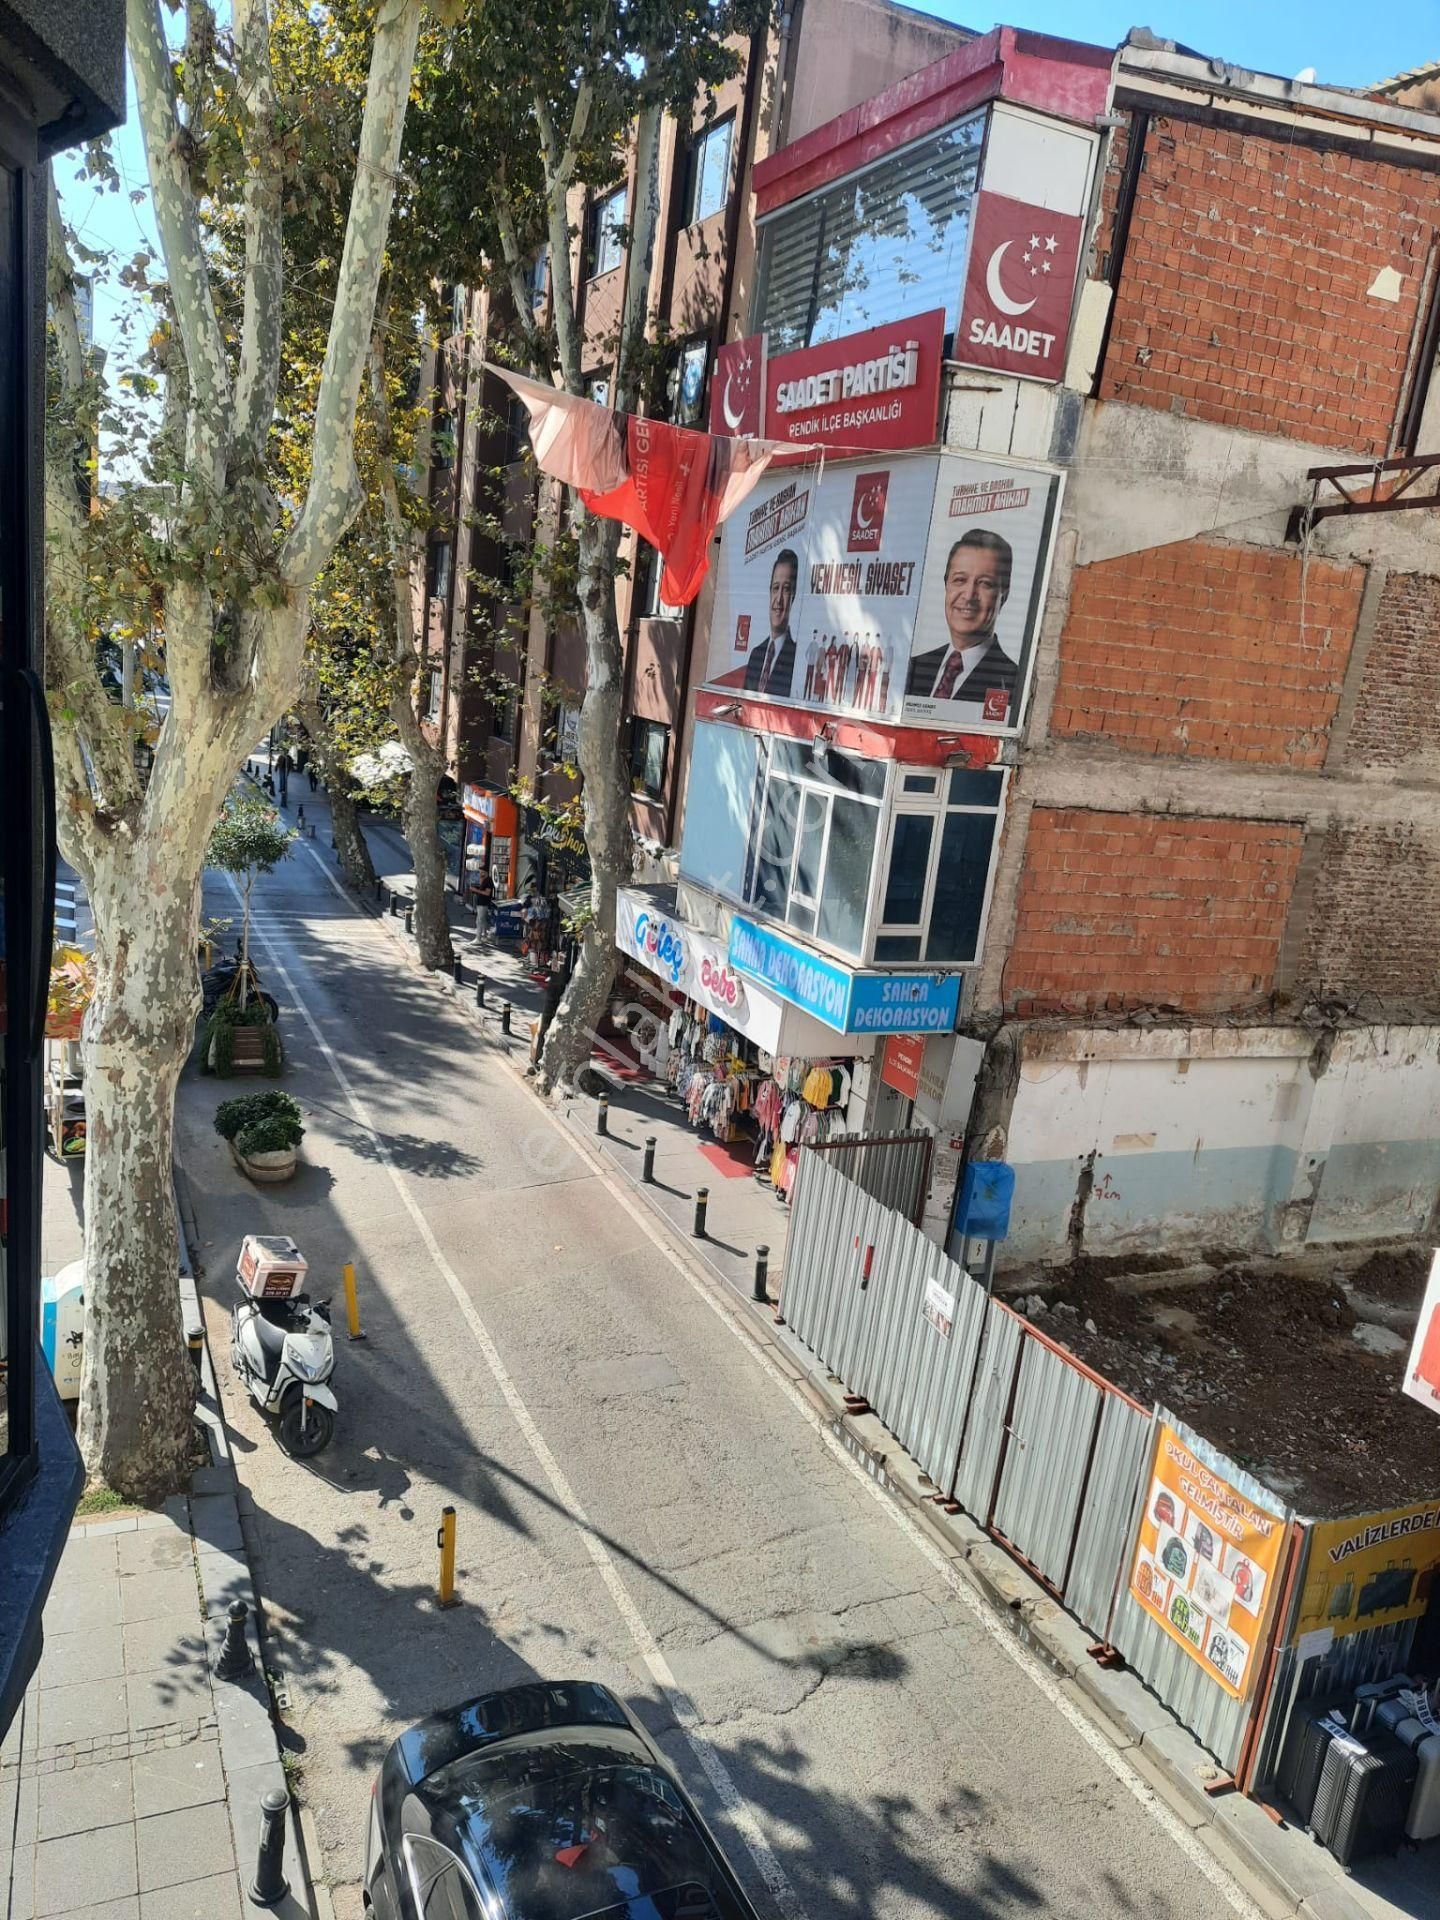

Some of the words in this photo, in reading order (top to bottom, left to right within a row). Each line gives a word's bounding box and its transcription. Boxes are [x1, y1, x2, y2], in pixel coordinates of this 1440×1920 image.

[968, 318, 1056, 359] SAADET
[776, 367, 841, 414] SAADET
[842, 340, 919, 398] PARTİSİ
[789, 415, 820, 438] PENDİK
[821, 411, 843, 434] İLÇE
[842, 401, 902, 431] BAŞKANLIĞI
[851, 528, 878, 541] SAADET
[810, 558, 833, 595] YENİ
[833, 557, 862, 595] NESİL
[865, 557, 915, 596] SİYASET
[701, 958, 737, 1004] Bebe
[767, 946, 846, 1020] DEKORASYON
[853, 1006, 950, 1028] DEKORASYON
[1164, 1440, 1198, 1476] OKUL
[1199, 1467, 1272, 1538] ÇANTALARI
[1179, 1475, 1245, 1541] GELMİŞTİR
[1328, 1510, 1434, 1563] VALİZLERDE
